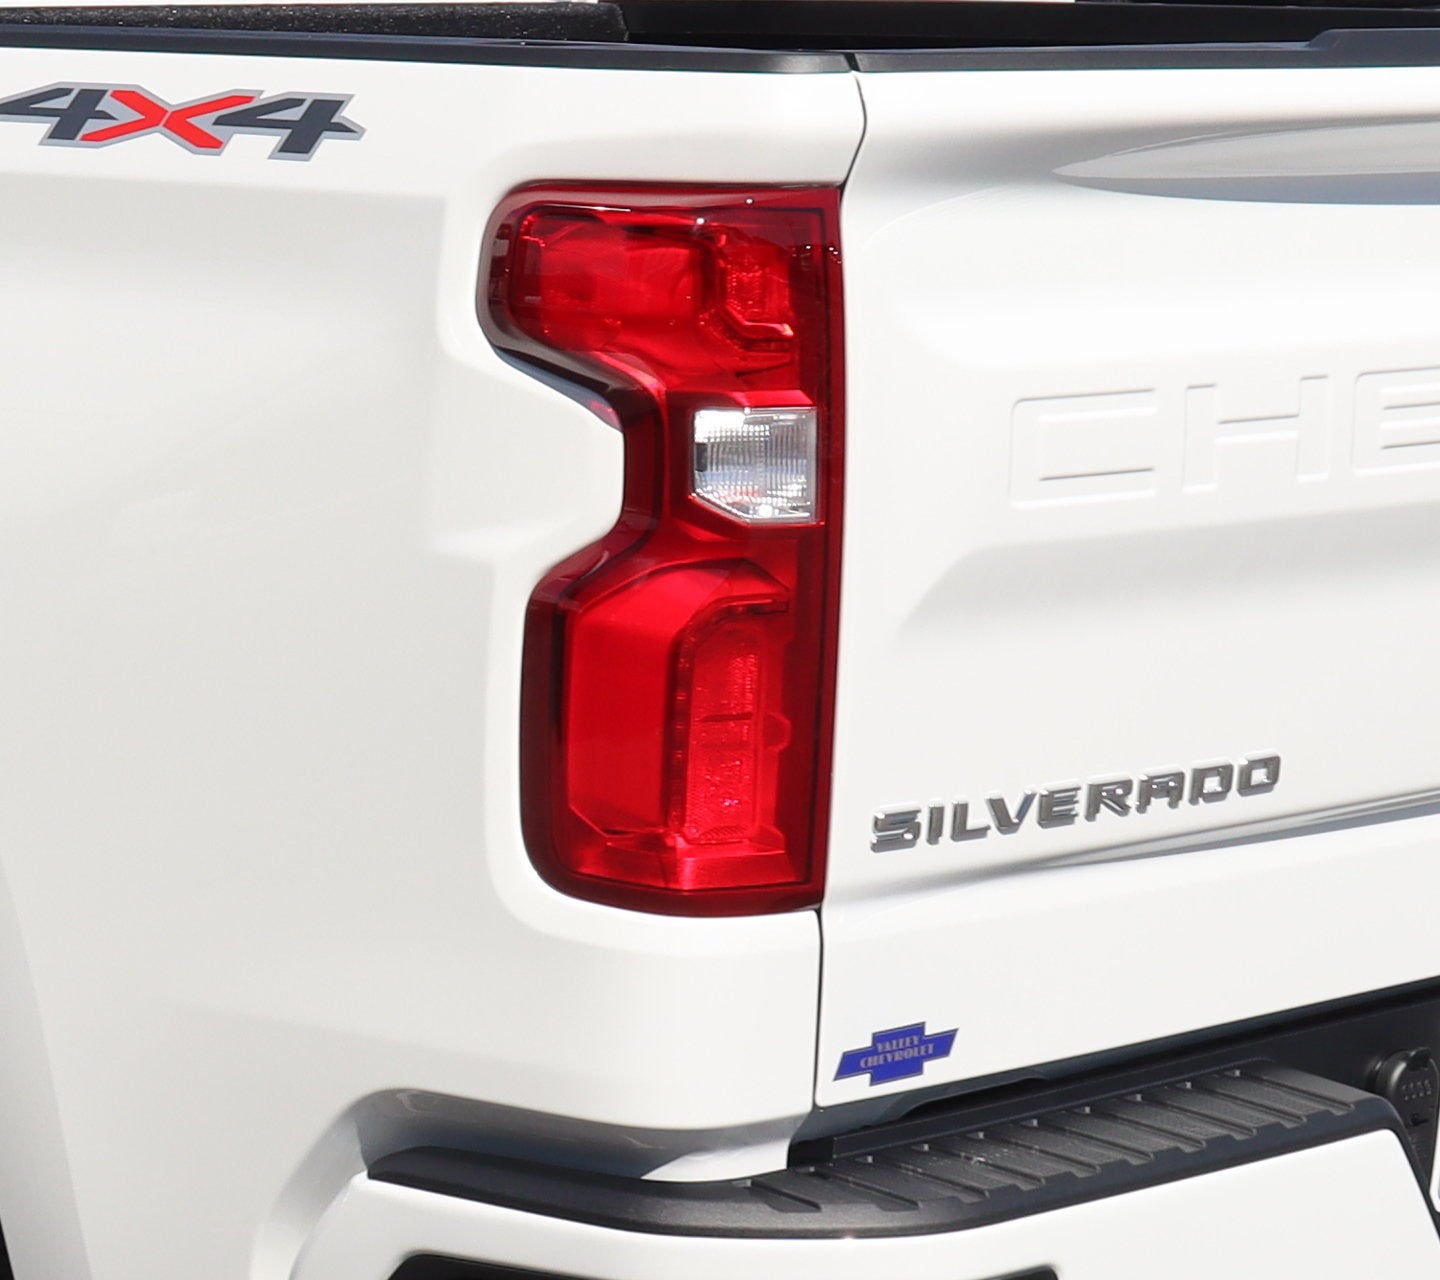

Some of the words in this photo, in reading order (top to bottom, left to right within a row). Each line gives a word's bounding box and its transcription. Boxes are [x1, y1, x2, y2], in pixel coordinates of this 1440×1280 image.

[870, 750, 1282, 853] SILVERADO
[859, 1042, 935, 1069] CHEVROLET
[876, 1034, 920, 1053] VALLEY
